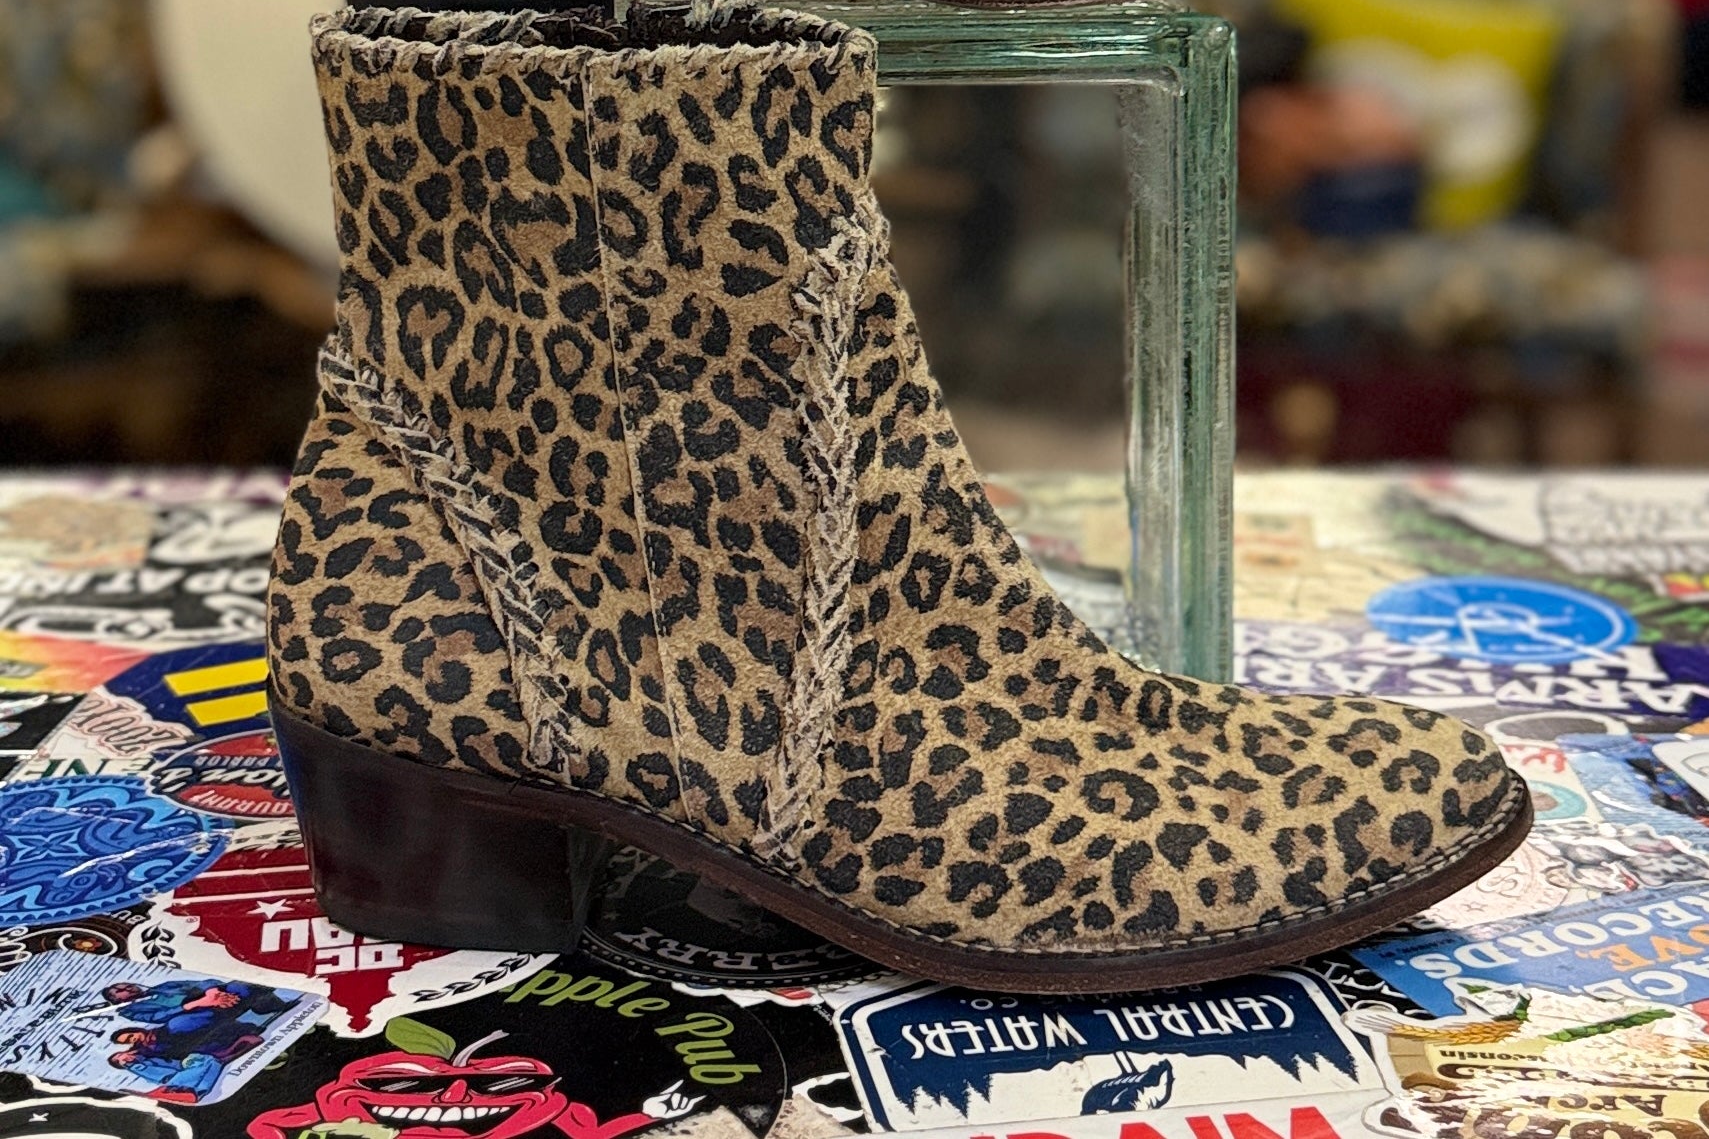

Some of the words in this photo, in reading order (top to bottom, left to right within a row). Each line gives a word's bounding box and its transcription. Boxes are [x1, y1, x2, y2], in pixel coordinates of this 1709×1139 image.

[499, 969, 670, 1018] pple
[654, 1012, 762, 1084] Pub
[901, 1013, 1085, 1060] WATERS
[1093, 994, 1295, 1043] CENTRAL
